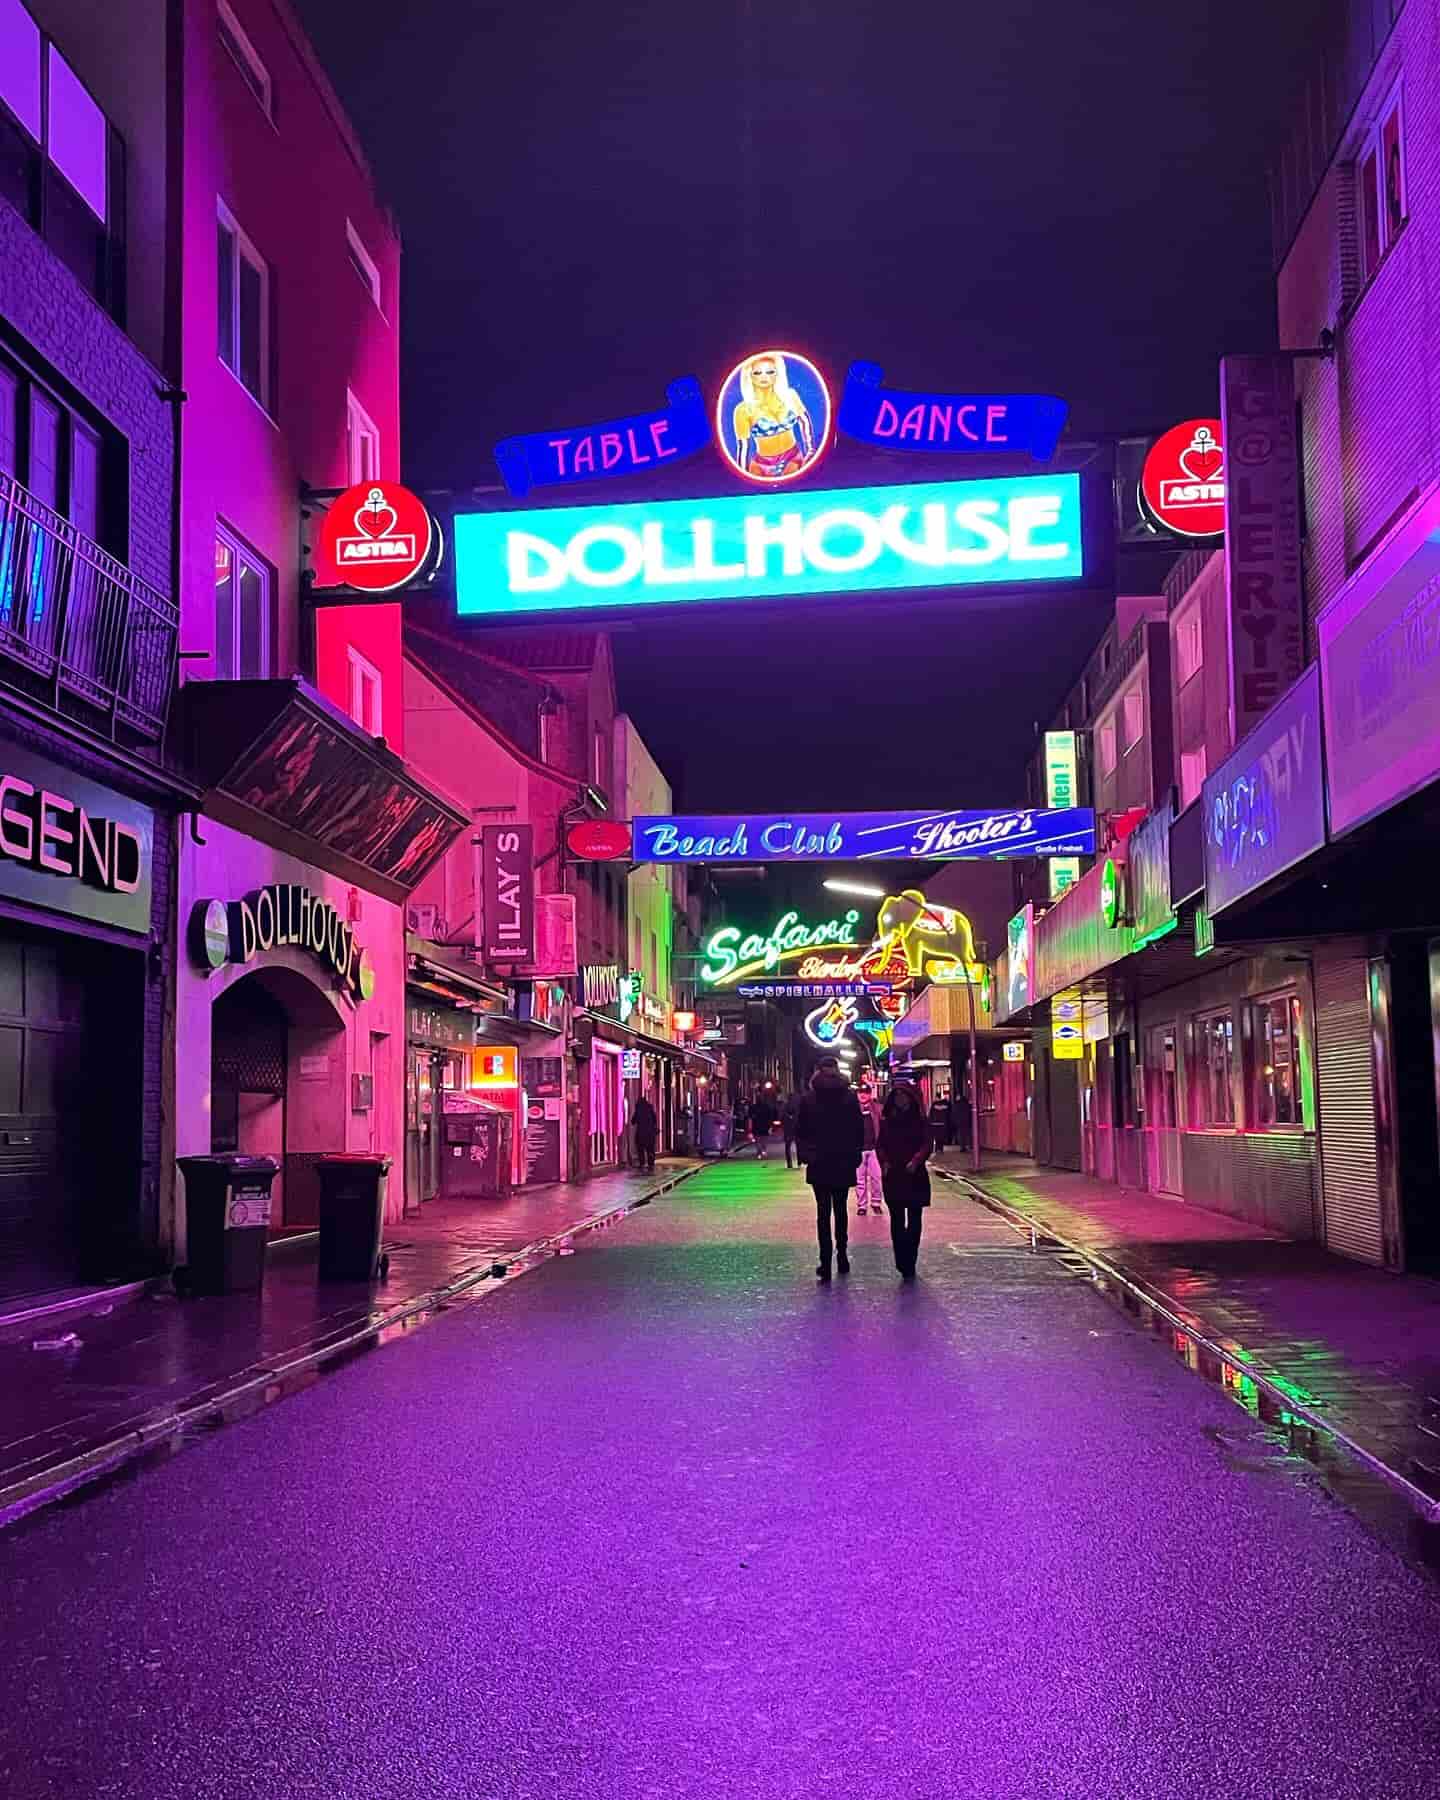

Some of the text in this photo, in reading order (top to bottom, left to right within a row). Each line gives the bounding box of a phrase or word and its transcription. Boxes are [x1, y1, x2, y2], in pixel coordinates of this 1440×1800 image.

[873, 399, 1008, 443] DANCE
[549, 420, 677, 475] TABLE
[343, 541, 409, 558] ASTRA
[506, 494, 1068, 593] DOLLHOUSE
[644, 811, 1033, 856] Beach Club Shooter's
[498, 832, 521, 939] ILAY'S
[701, 909, 860, 983] Safari
[764, 984, 865, 997] SPIELHALLE
